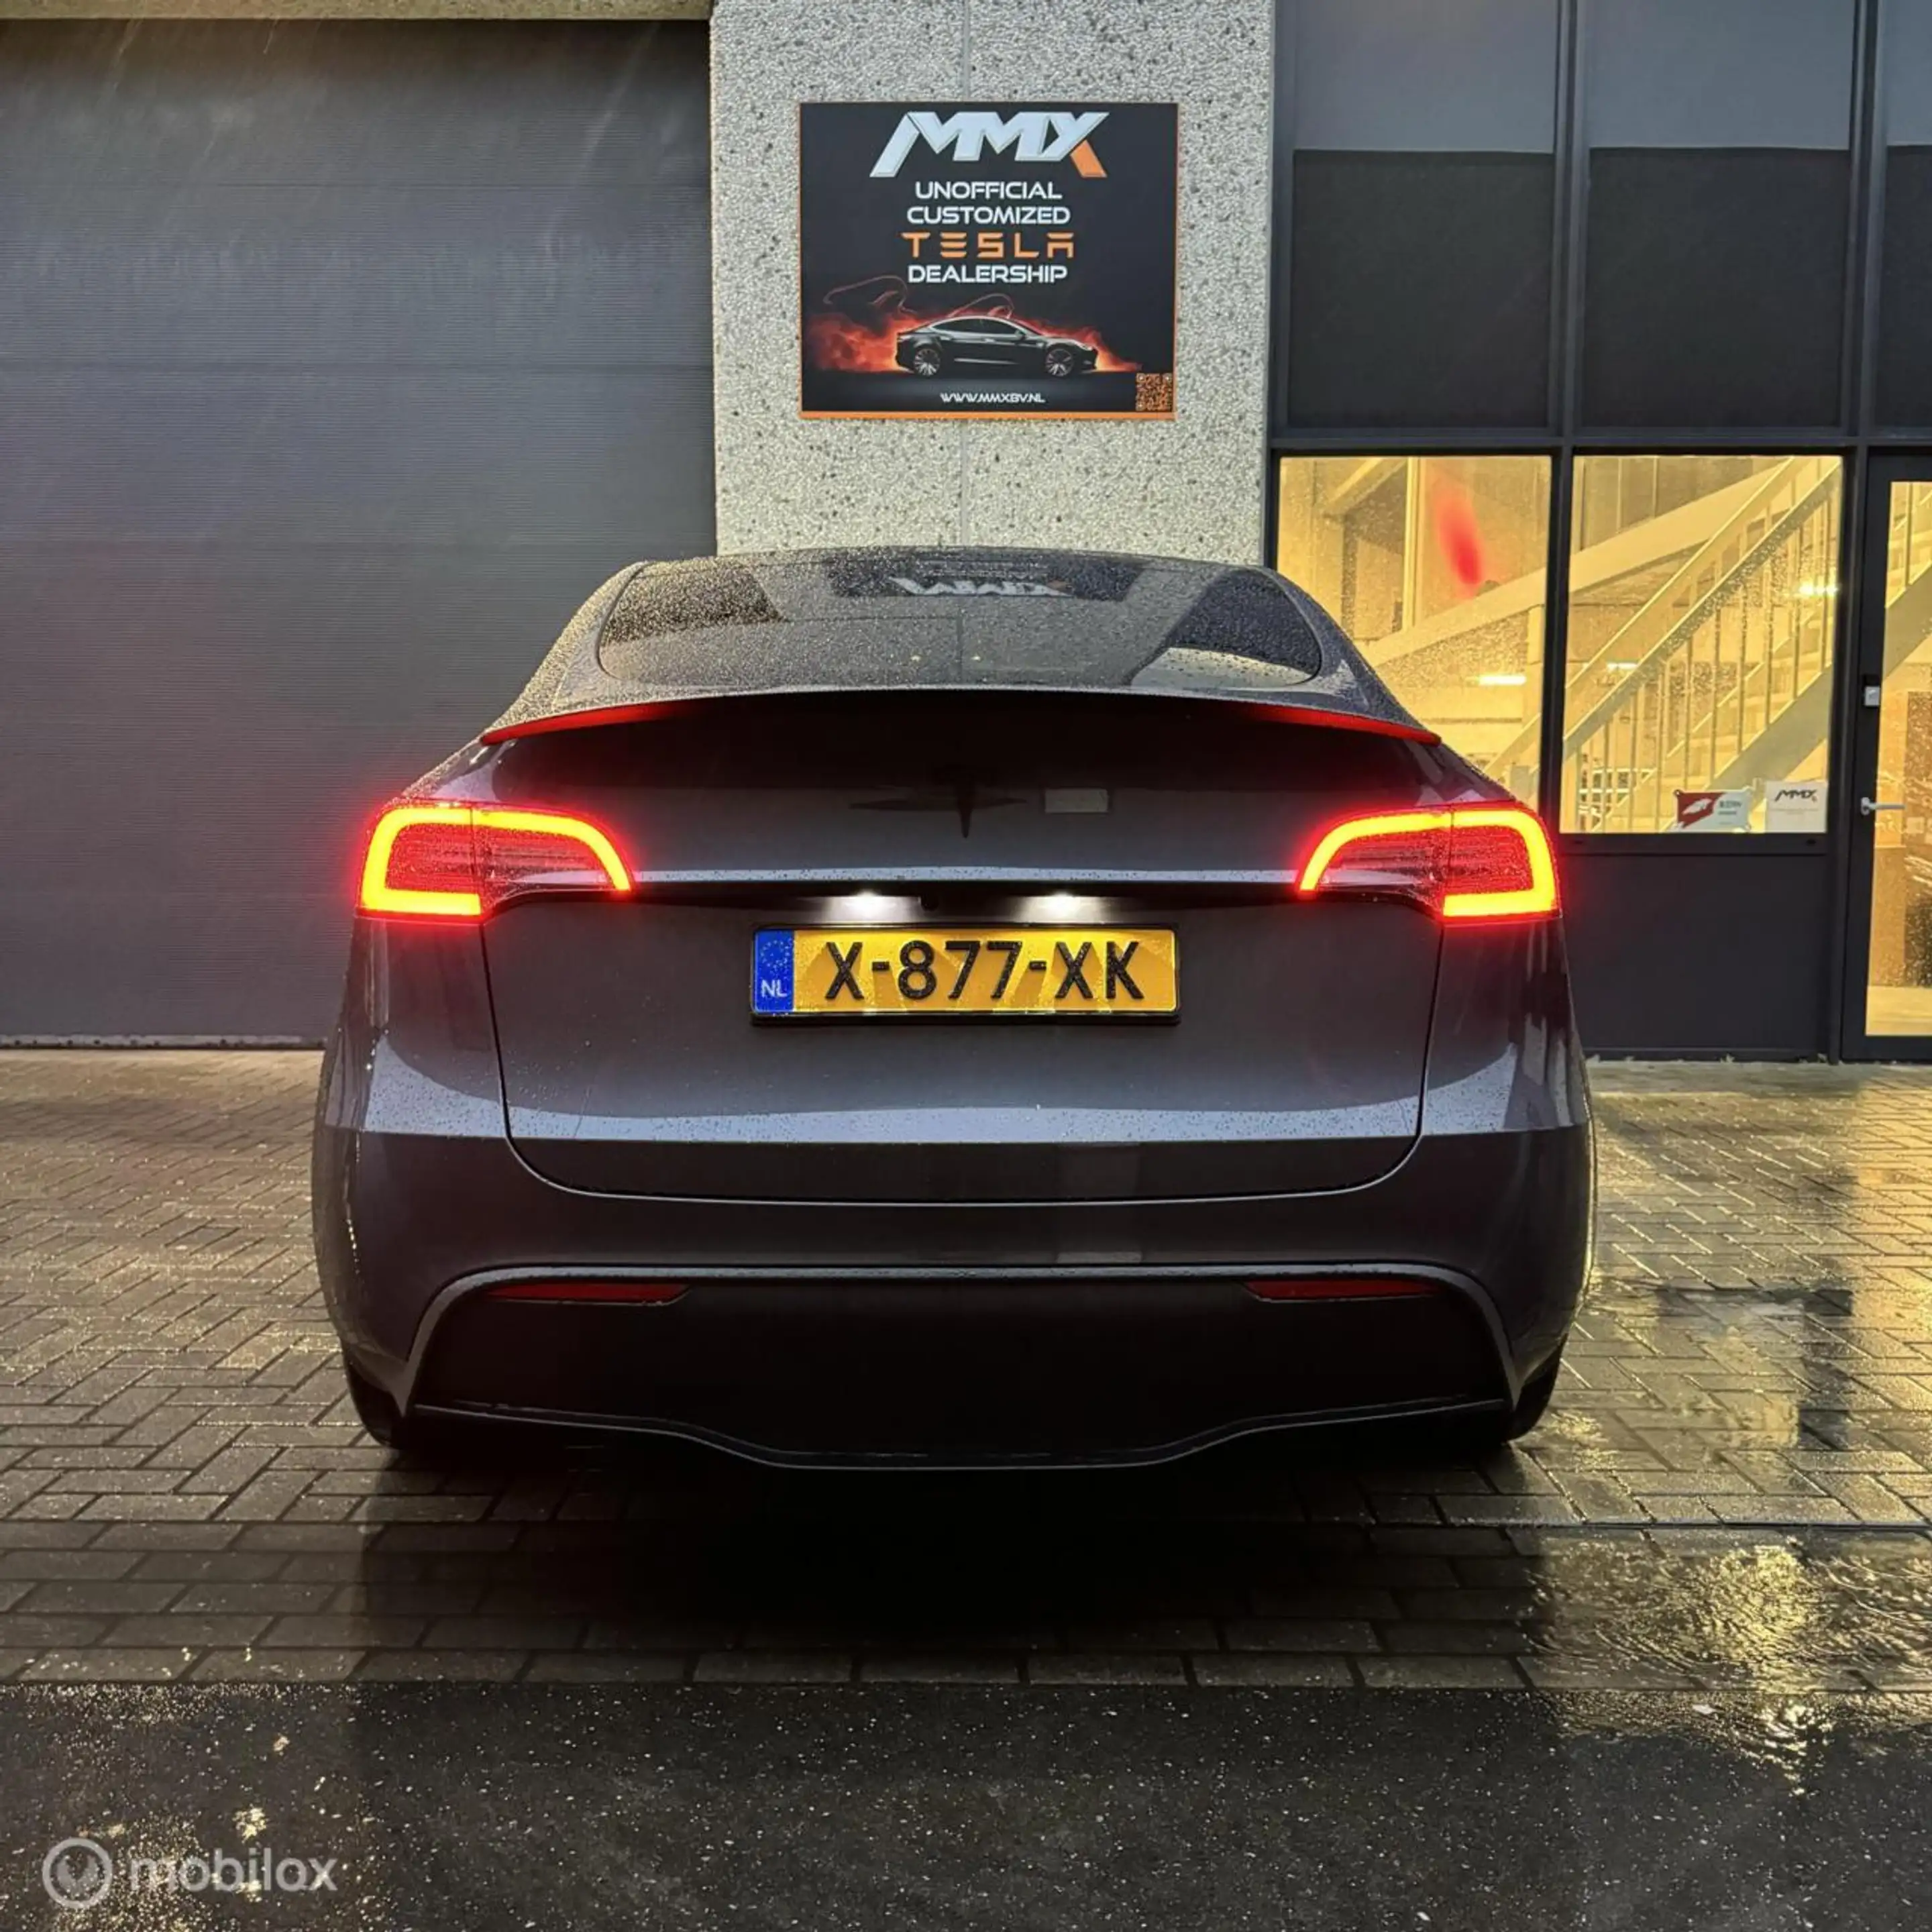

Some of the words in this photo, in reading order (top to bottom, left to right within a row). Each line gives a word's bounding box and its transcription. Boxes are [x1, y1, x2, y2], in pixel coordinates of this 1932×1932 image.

[869, 111, 1110, 178] MMX
[915, 181, 1062, 199] UNOFFICIAL
[907, 207, 1071, 224] CUSTOMIZED
[902, 232, 1074, 258] TESLA
[908, 266, 1068, 283] DEALERSHIP
[825, 941, 1144, 1000] X-877-XK
[760, 980, 788, 998] NL
